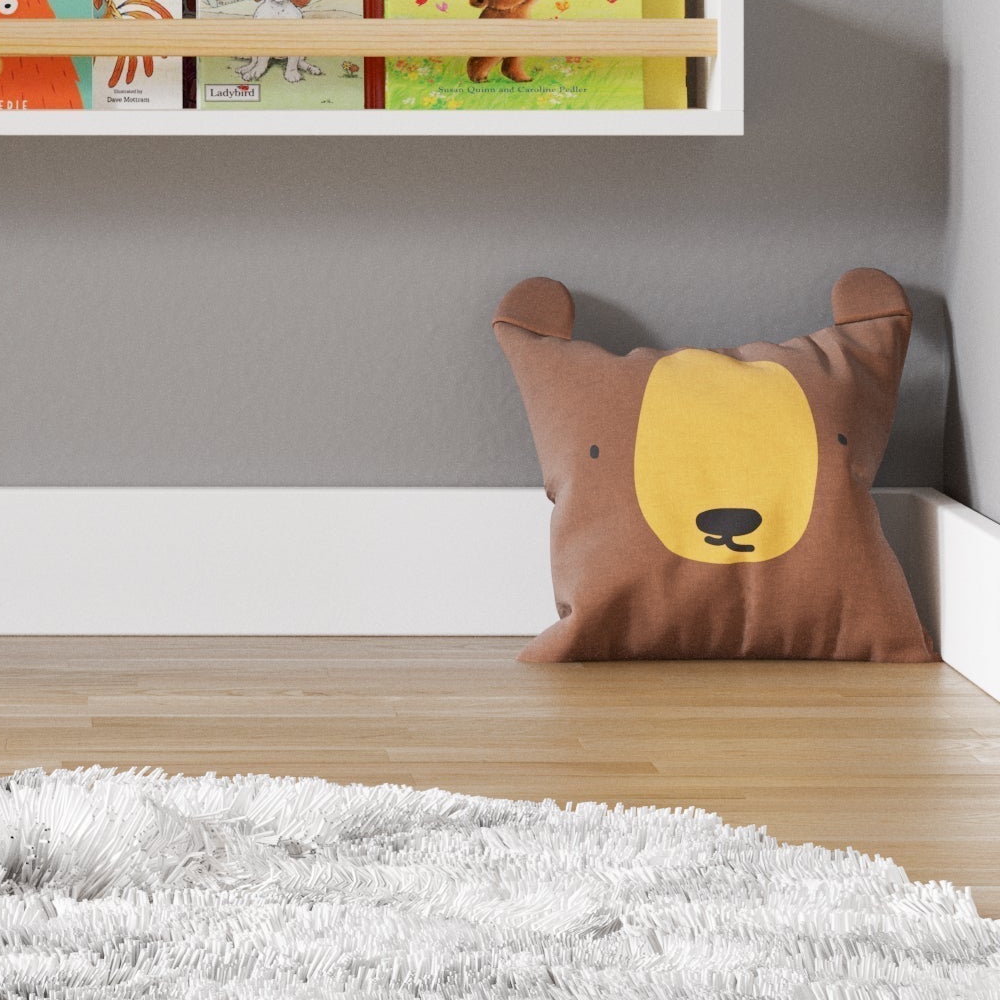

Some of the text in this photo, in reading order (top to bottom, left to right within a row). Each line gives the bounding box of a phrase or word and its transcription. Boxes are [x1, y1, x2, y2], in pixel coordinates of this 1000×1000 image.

[210, 88, 255, 98] Ladybird
[438, 85, 587, 94] Susan Quinn and Caroline Pedler
